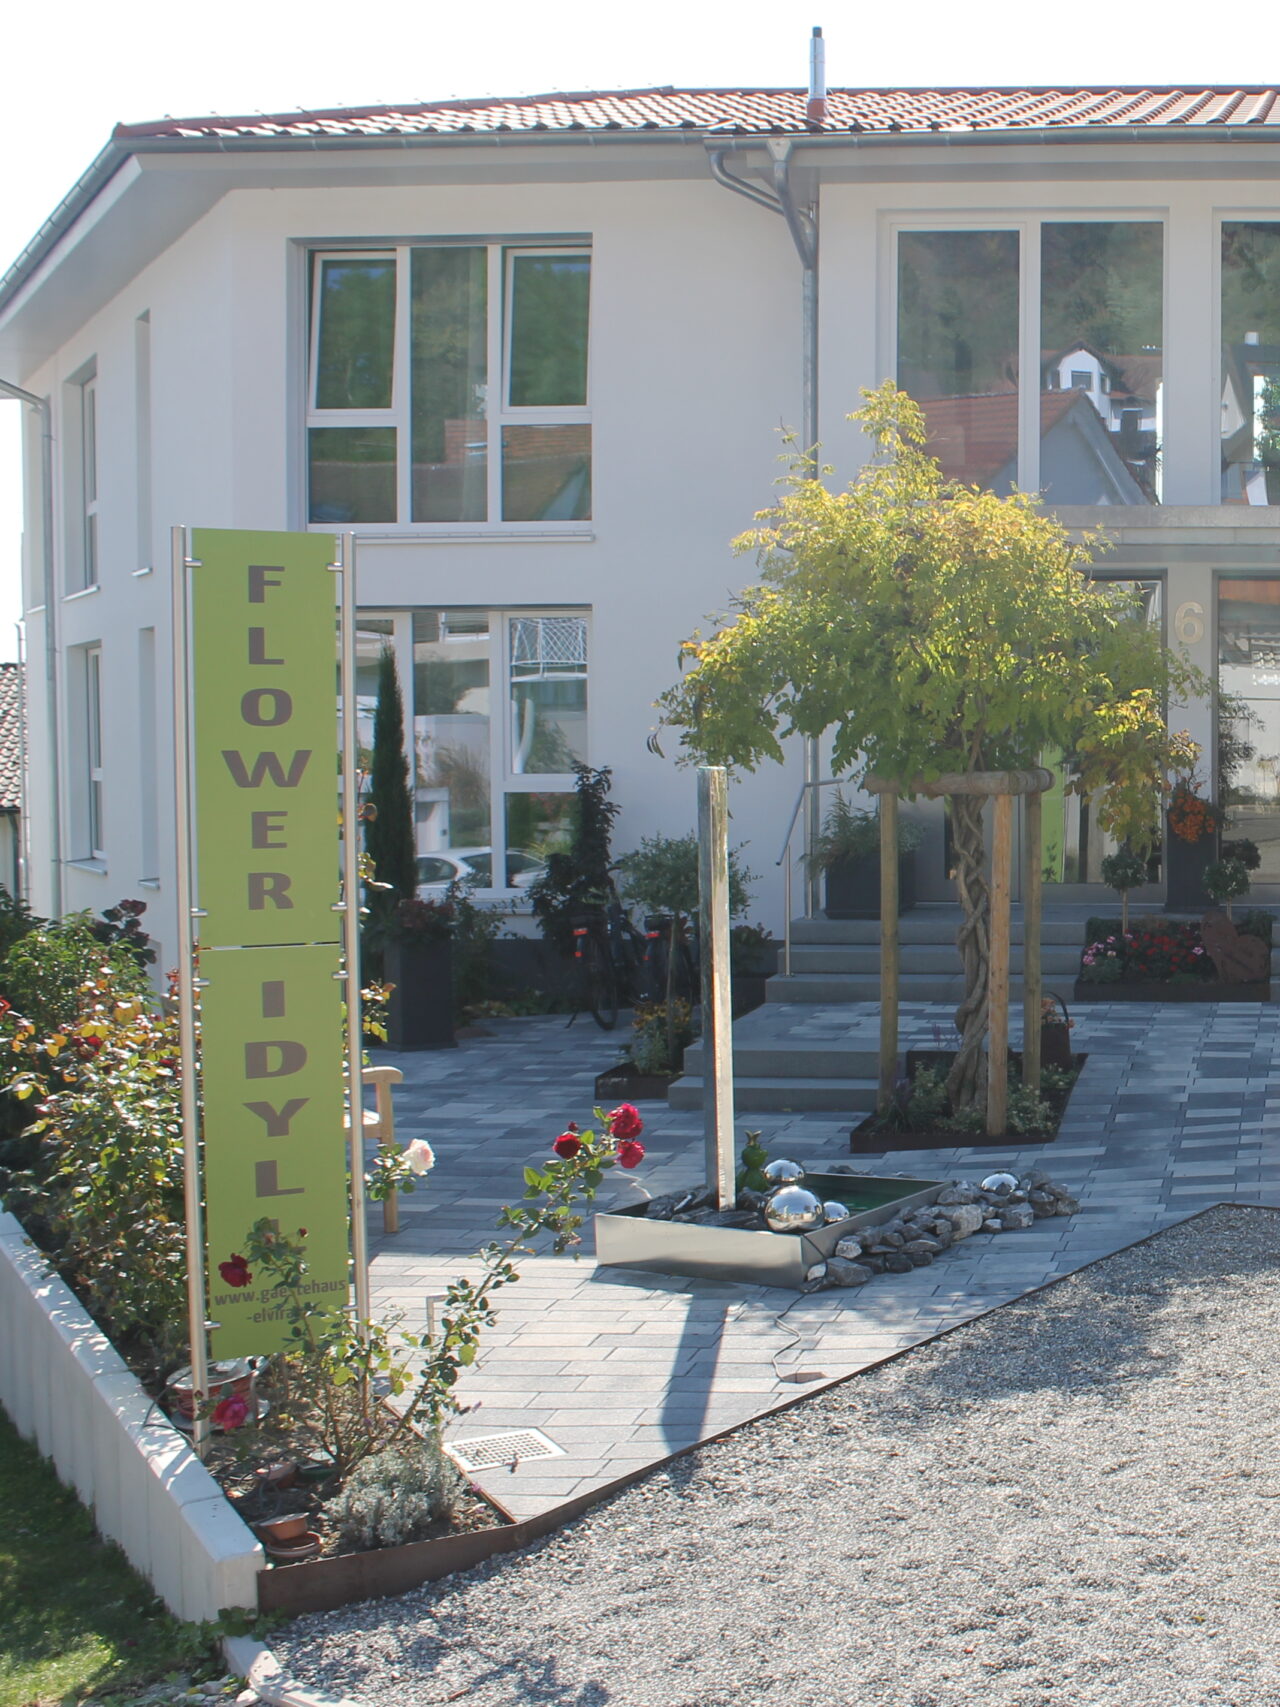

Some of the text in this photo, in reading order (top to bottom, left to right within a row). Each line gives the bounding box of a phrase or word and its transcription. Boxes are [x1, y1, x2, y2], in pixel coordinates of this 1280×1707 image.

[1174, 601, 1204, 644] 6
[221, 564, 312, 911] FLOWER
[214, 1279, 346, 1306] www.gaetehaus
